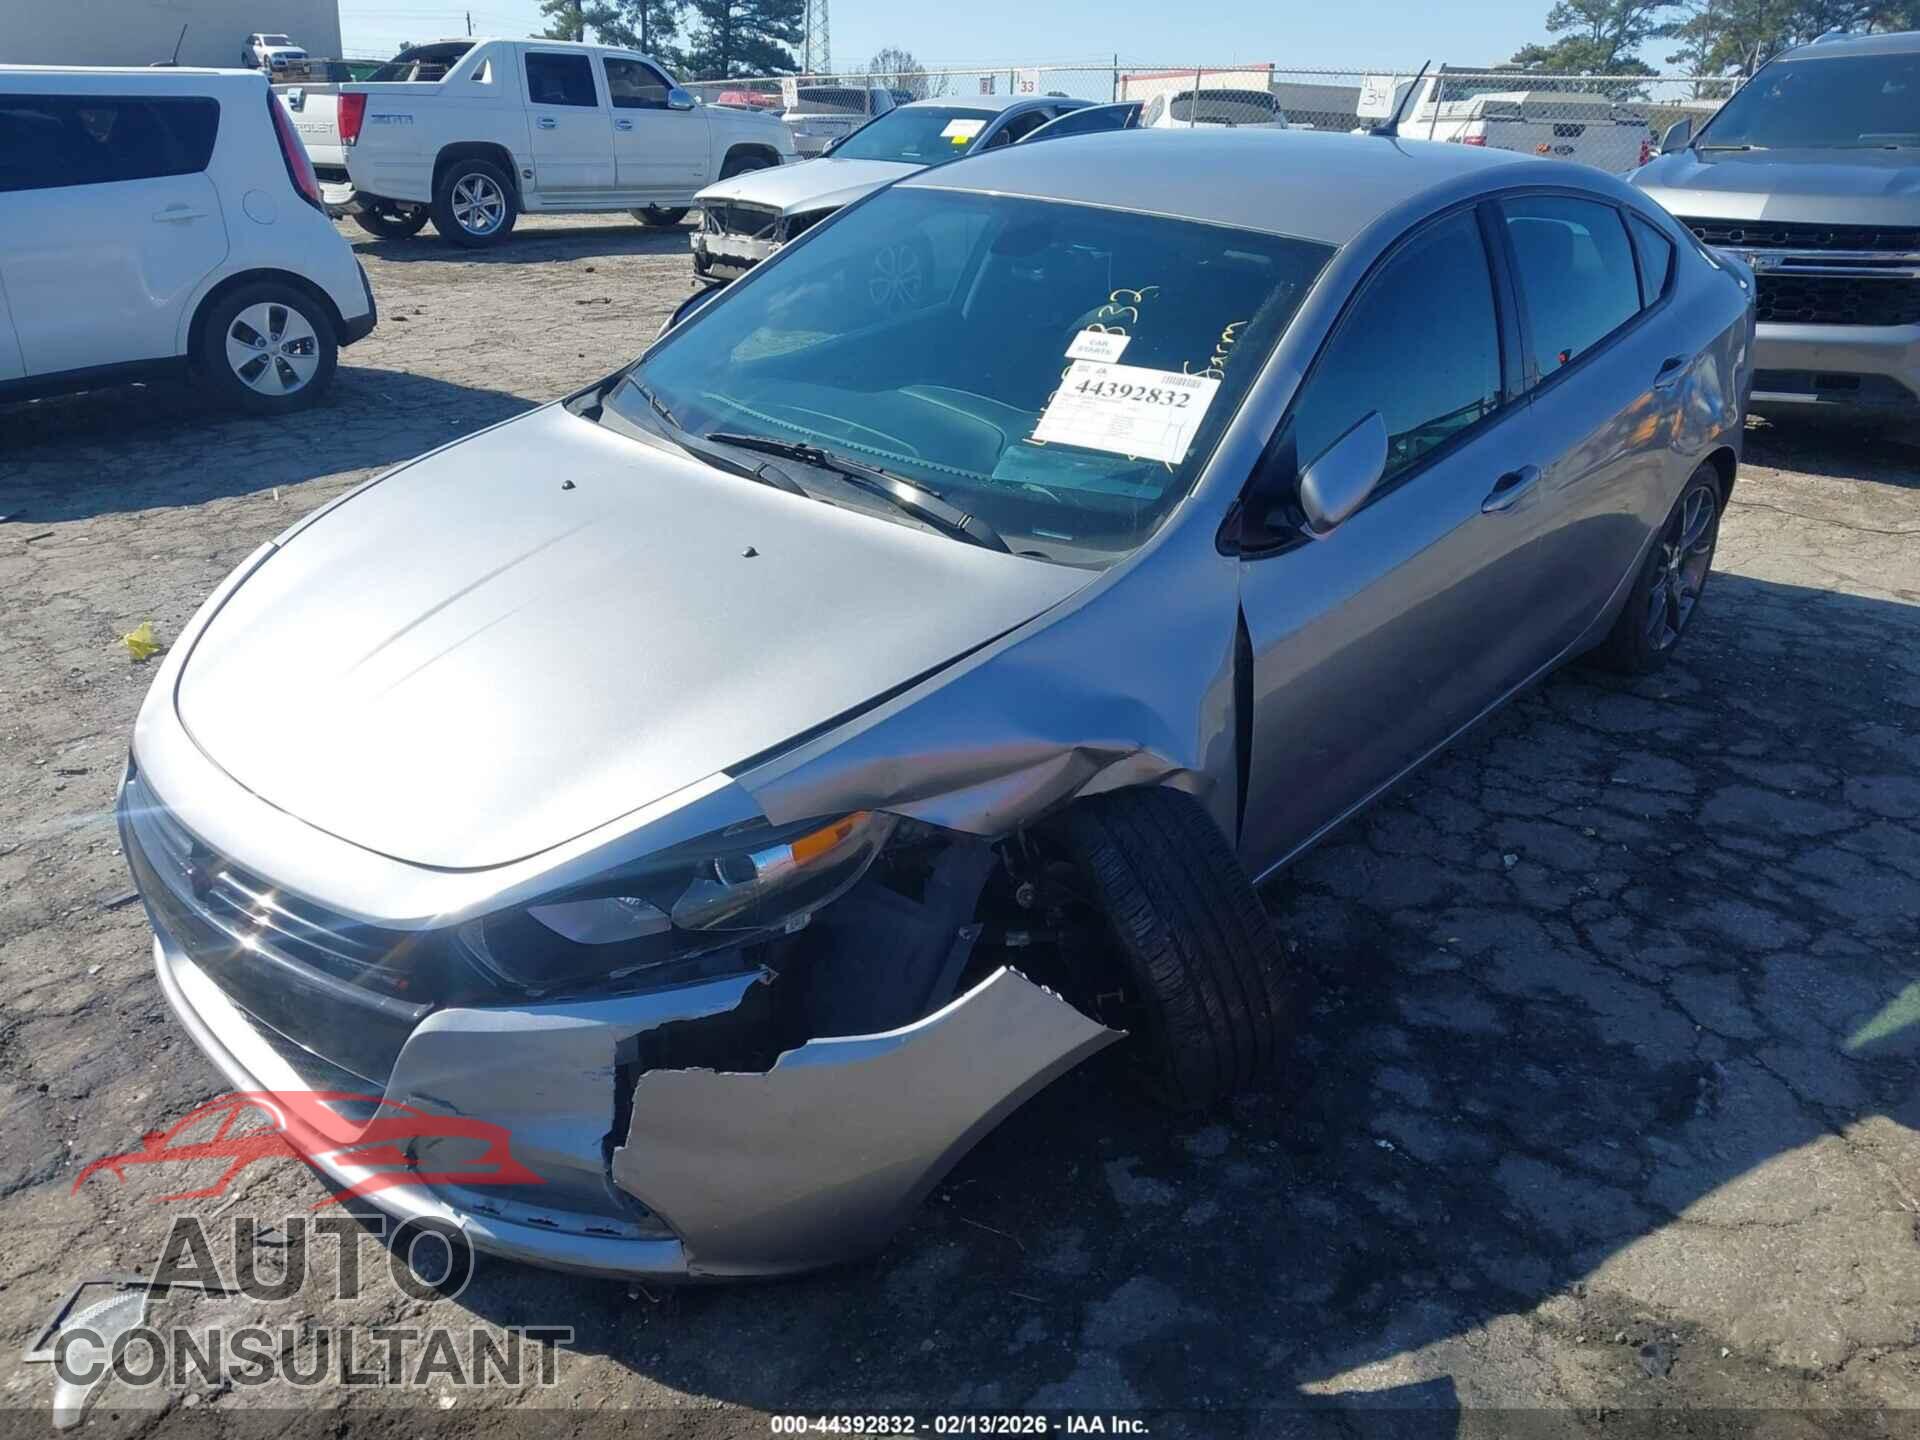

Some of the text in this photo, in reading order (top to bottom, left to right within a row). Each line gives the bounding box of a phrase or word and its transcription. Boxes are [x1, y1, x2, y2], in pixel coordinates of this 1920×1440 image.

[1020, 80, 1034, 92] 33
[1363, 88, 1387, 107] 34
[1075, 379, 1191, 409] 44392832
